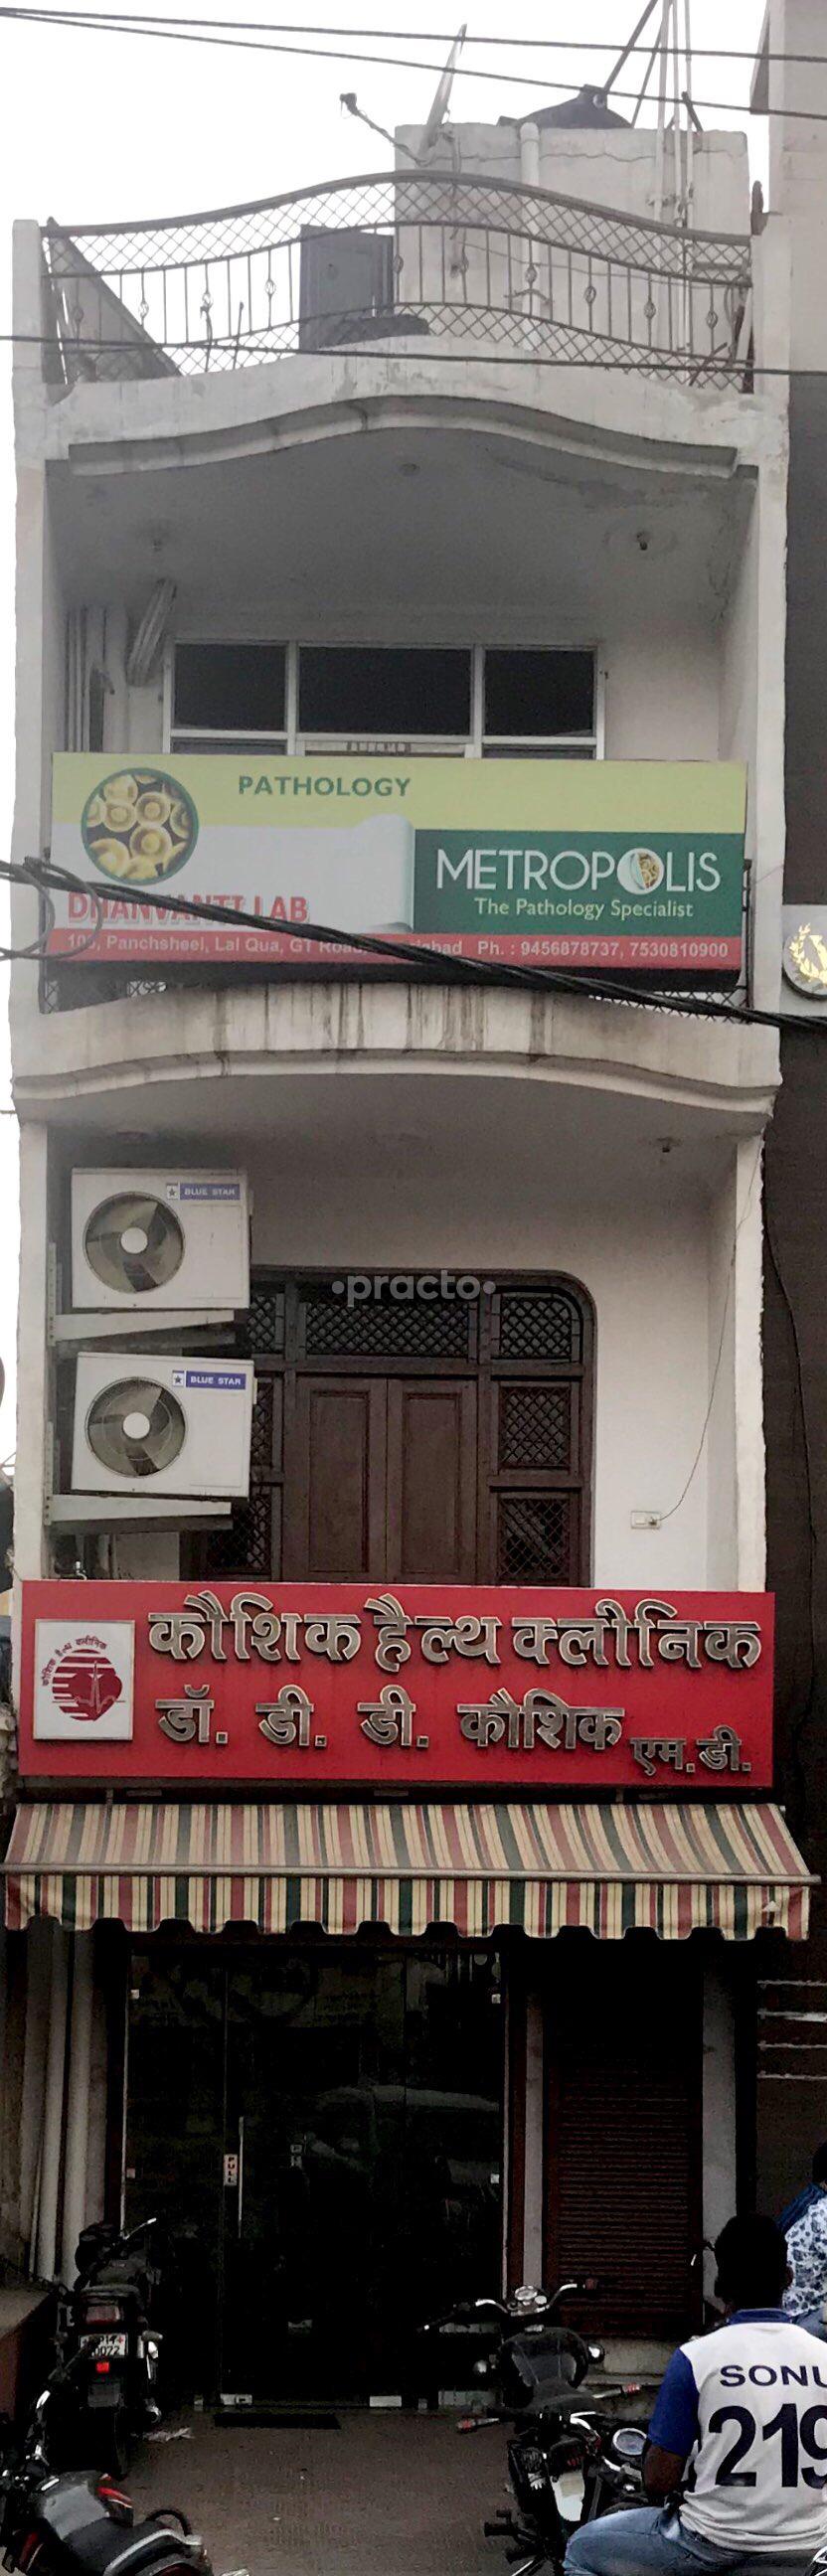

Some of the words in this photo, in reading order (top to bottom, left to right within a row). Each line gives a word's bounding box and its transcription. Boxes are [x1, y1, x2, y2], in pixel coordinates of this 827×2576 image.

[239, 775, 411, 797] PATHOLOGY
[436, 848, 721, 894] METROPOLIS
[253, 895, 308, 923] LAB
[474, 896, 509, 915] The
[516, 898, 604, 921] Pathology
[610, 899, 694, 920] Specialist
[215, 936, 241, 953] Lal
[245, 938, 284, 957] Qua,
[289, 939, 314, 954] GT
[520, 940, 624, 959] 9456878737,
[629, 942, 729, 958] 7530810900
[184, 1188, 209, 1197] BLUE
[212, 1188, 236, 1197] STAR
[190, 1375, 214, 1385] BLUE
[217, 1376, 242, 1386] STAR
[148, 1590, 362, 1663] कौशिक
[364, 1593, 502, 1674] हैल्थ
[511, 1598, 762, 1669] क्लीनिक
[155, 1684, 228, 1744] डॉ.
[254, 1684, 328, 1747] डी.
[357, 1684, 430, 1748] डी.
[457, 1688, 625, 1750] कौशिक
